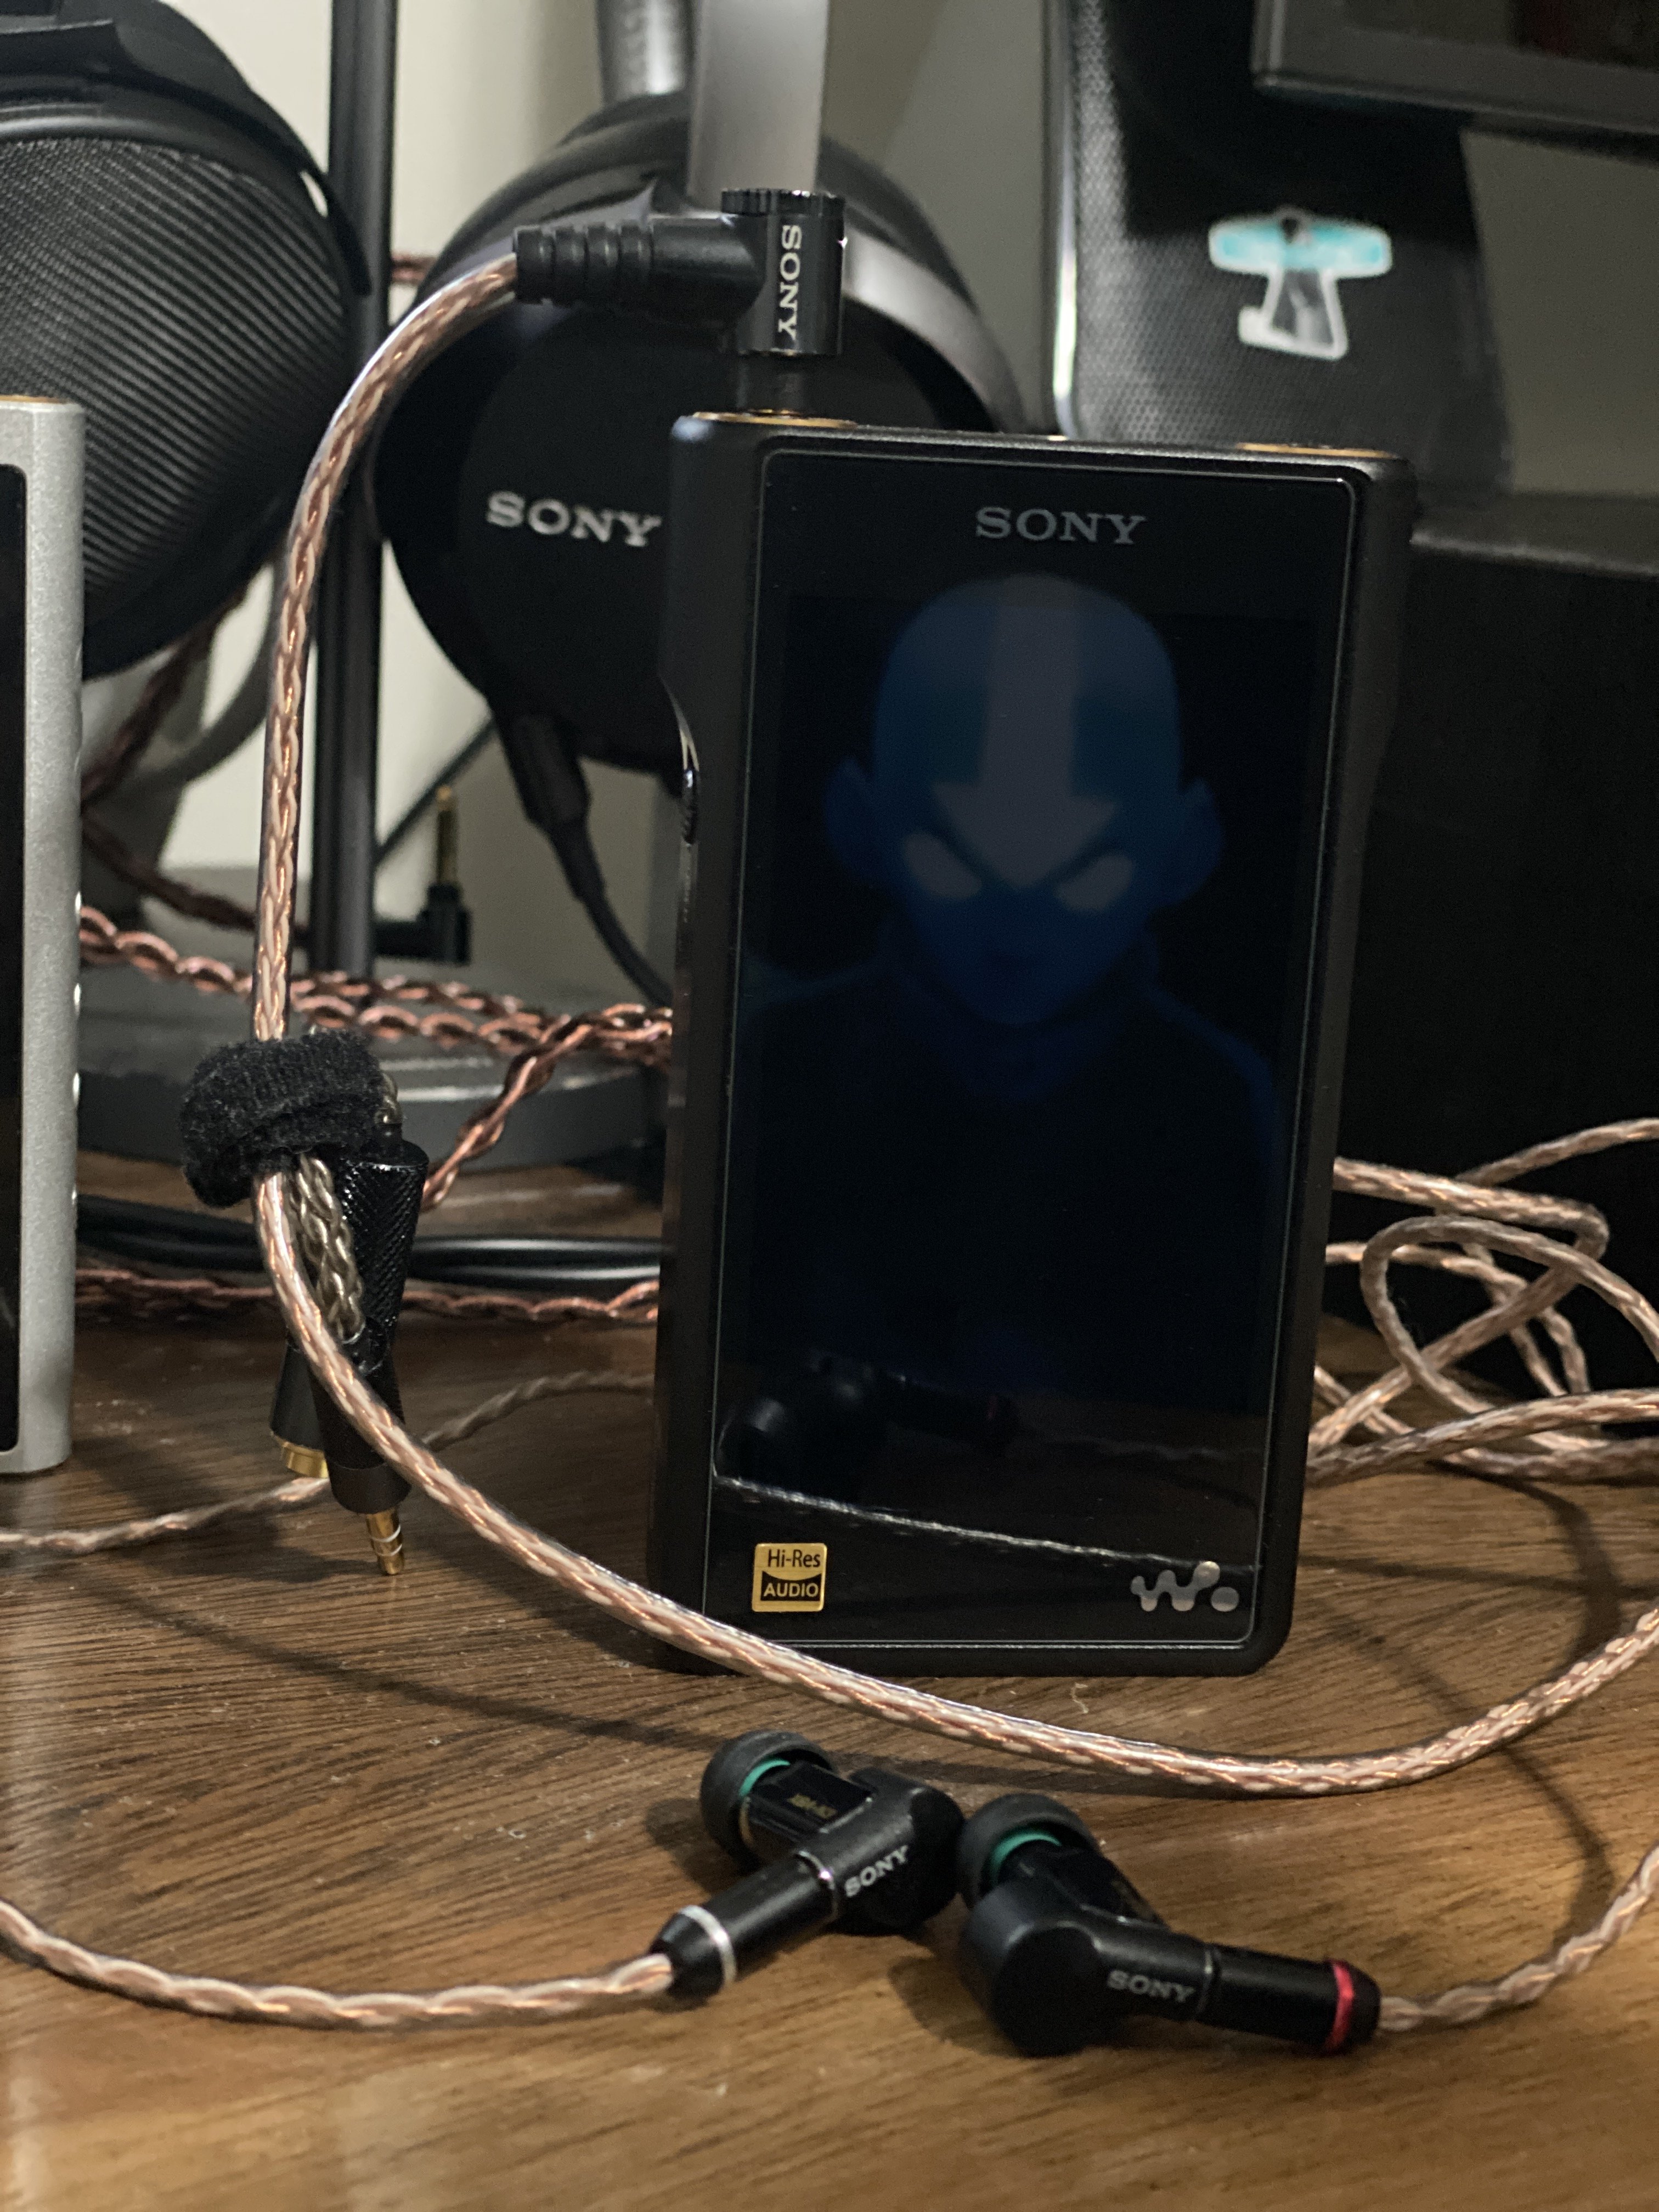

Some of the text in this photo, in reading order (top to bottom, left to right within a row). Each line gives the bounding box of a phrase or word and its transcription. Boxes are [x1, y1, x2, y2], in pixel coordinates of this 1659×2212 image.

[778, 224, 803, 341] SONY
[486, 491, 662, 547] SONY
[976, 507, 1146, 545] SONY
[768, 1549, 821, 1568] Hi-Res
[763, 1582, 819, 1598] AUDIO
[844, 1845, 909, 1898] SONY
[1107, 1970, 1197, 2002] SONY
